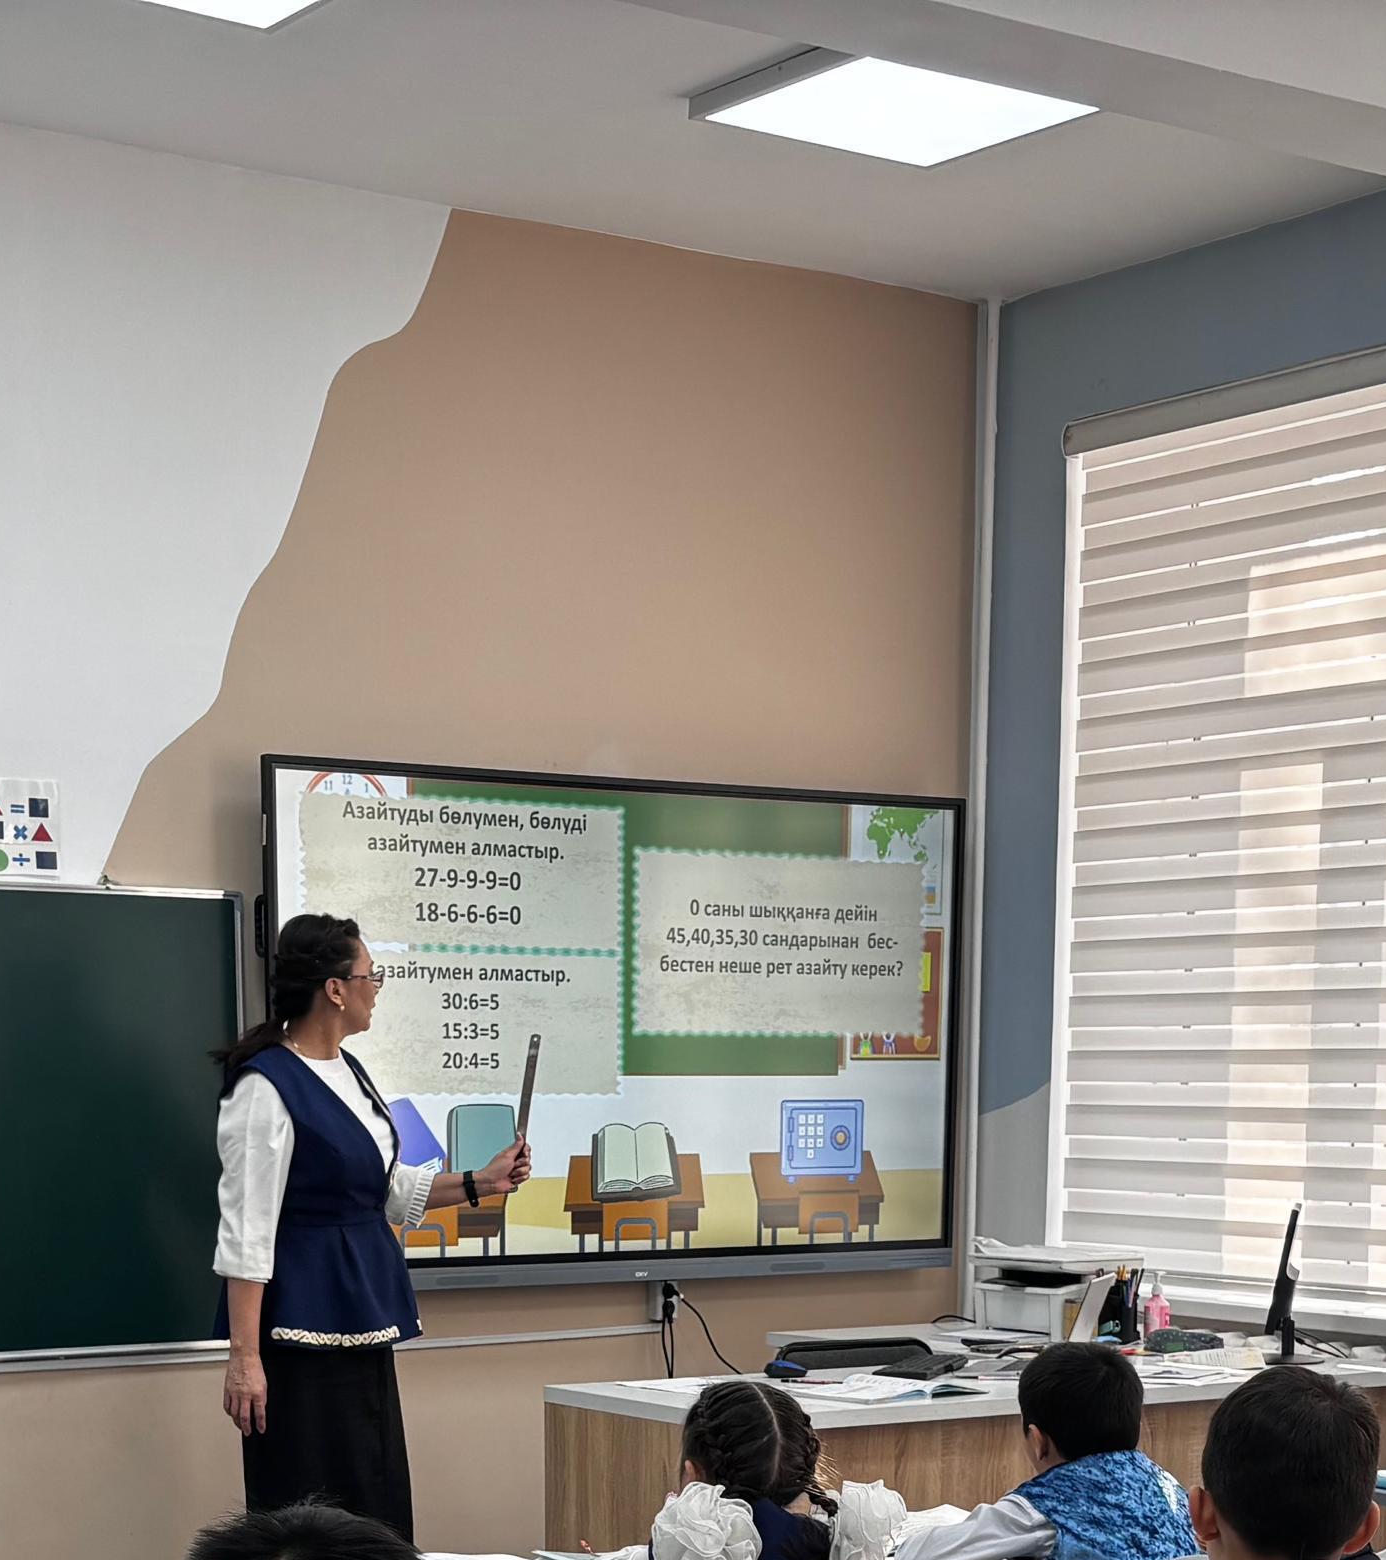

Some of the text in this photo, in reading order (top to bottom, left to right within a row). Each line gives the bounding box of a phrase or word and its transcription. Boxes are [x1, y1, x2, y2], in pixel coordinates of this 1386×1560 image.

[341, 774, 353, 786] 12
[342, 801, 588, 833] Азайтуды бөлумен, бөлуді
[367, 835, 565, 864] азайтумен алмастыр.
[414, 867, 522, 891] 27-9-9-9=0
[414, 902, 522, 926] 18-6-6-6=0
[689, 899, 878, 924] 0 саны шыққанға дейін
[666, 927, 899, 952] 45,40,35,30 сандарынан бес-
[376, 961, 571, 987] азайтумен алмастыр.
[659, 955, 904, 980] бестен неше рет азайту керек?
[441, 992, 500, 1011] 30:6=5
[441, 1022, 500, 1041] 15:3=5
[441, 1051, 500, 1070] 20:4=5
